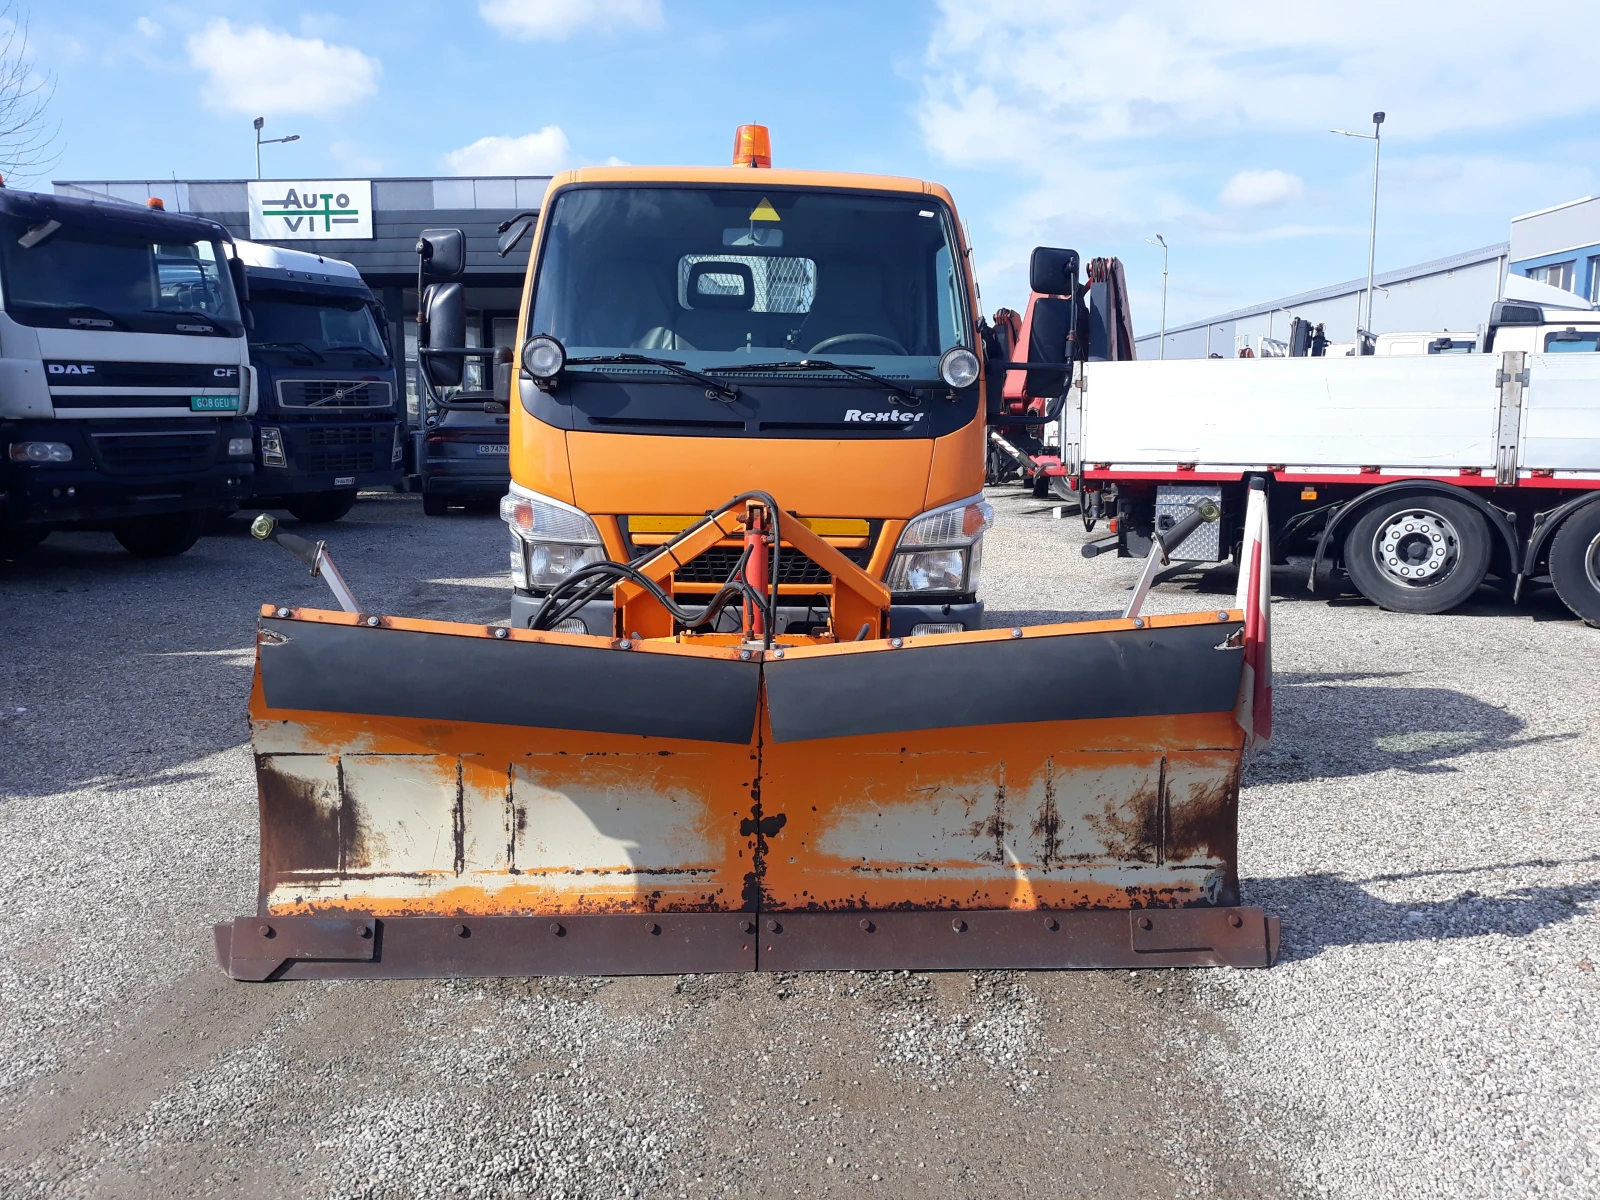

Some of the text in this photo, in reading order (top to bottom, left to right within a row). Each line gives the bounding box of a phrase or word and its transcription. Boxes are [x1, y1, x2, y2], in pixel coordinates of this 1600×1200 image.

[283, 216, 331, 232] VIT
[48, 364, 96, 374] DAF
[213, 368, 237, 377] CF
[843, 409, 924, 422] Rexter
